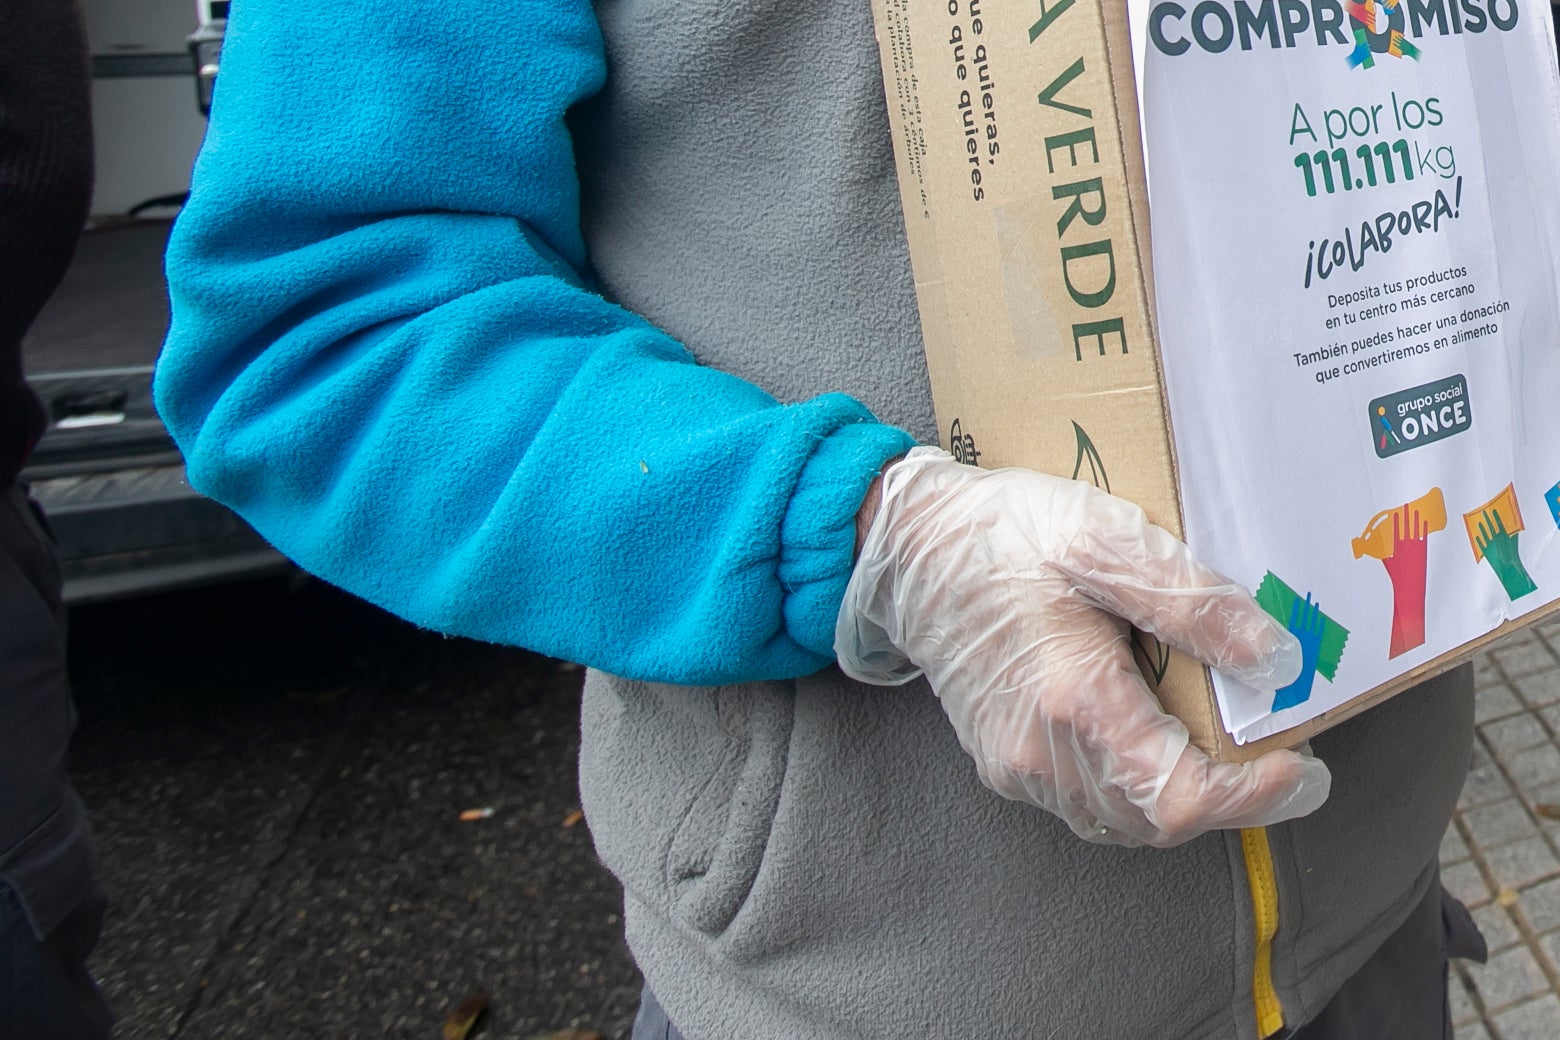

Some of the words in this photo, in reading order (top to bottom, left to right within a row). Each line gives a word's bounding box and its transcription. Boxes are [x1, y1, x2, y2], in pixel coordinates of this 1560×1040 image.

[886, 9, 893, 22] la
[901, 0, 909, 12] la
[887, 26, 904, 99] plantación
[903, 16, 914, 69] compra
[948, 24, 974, 81] que
[911, 73, 919, 91] de
[970, 44, 1000, 166] quieras,
[895, 12, 908, 73] colabora
[903, 77, 911, 103] con
[908, 121, 923, 184] céntimos
[920, 189, 927, 206] de
[900, 103, 907, 120] de
[913, 95, 922, 124] esta
[1289, 103, 1317, 145] A
[1324, 103, 1383, 149] por
[1392, 91, 1444, 131] los
[903, 124, 919, 175] árboles
[918, 127, 928, 156] caja
[957, 89, 985, 202] quieres
[1037, 56, 1129, 362] VERDE
[1325, 316, 1341, 330] en
[1343, 312, 1357, 325] tu
[1359, 302, 1398, 321] centro
[1400, 293, 1427, 311] más
[1429, 283, 1475, 303] cercano
[1328, 285, 1380, 309] Deposita
[1382, 281, 1403, 295] tus
[1406, 266, 1467, 291] productos
[1293, 343, 1348, 367] También
[1350, 331, 1395, 355] puedes
[1396, 321, 1432, 340] hacer
[1435, 315, 1458, 330] una
[1460, 301, 1510, 324] donación
[1315, 367, 1340, 385] que
[1344, 342, 1430, 375] convertiremos
[1433, 337, 1449, 350] en
[1451, 323, 1498, 345] alimento
[1398, 395, 1433, 417] grupo
[1434, 383, 1464, 403] social
[1401, 401, 1466, 440] ONCE
